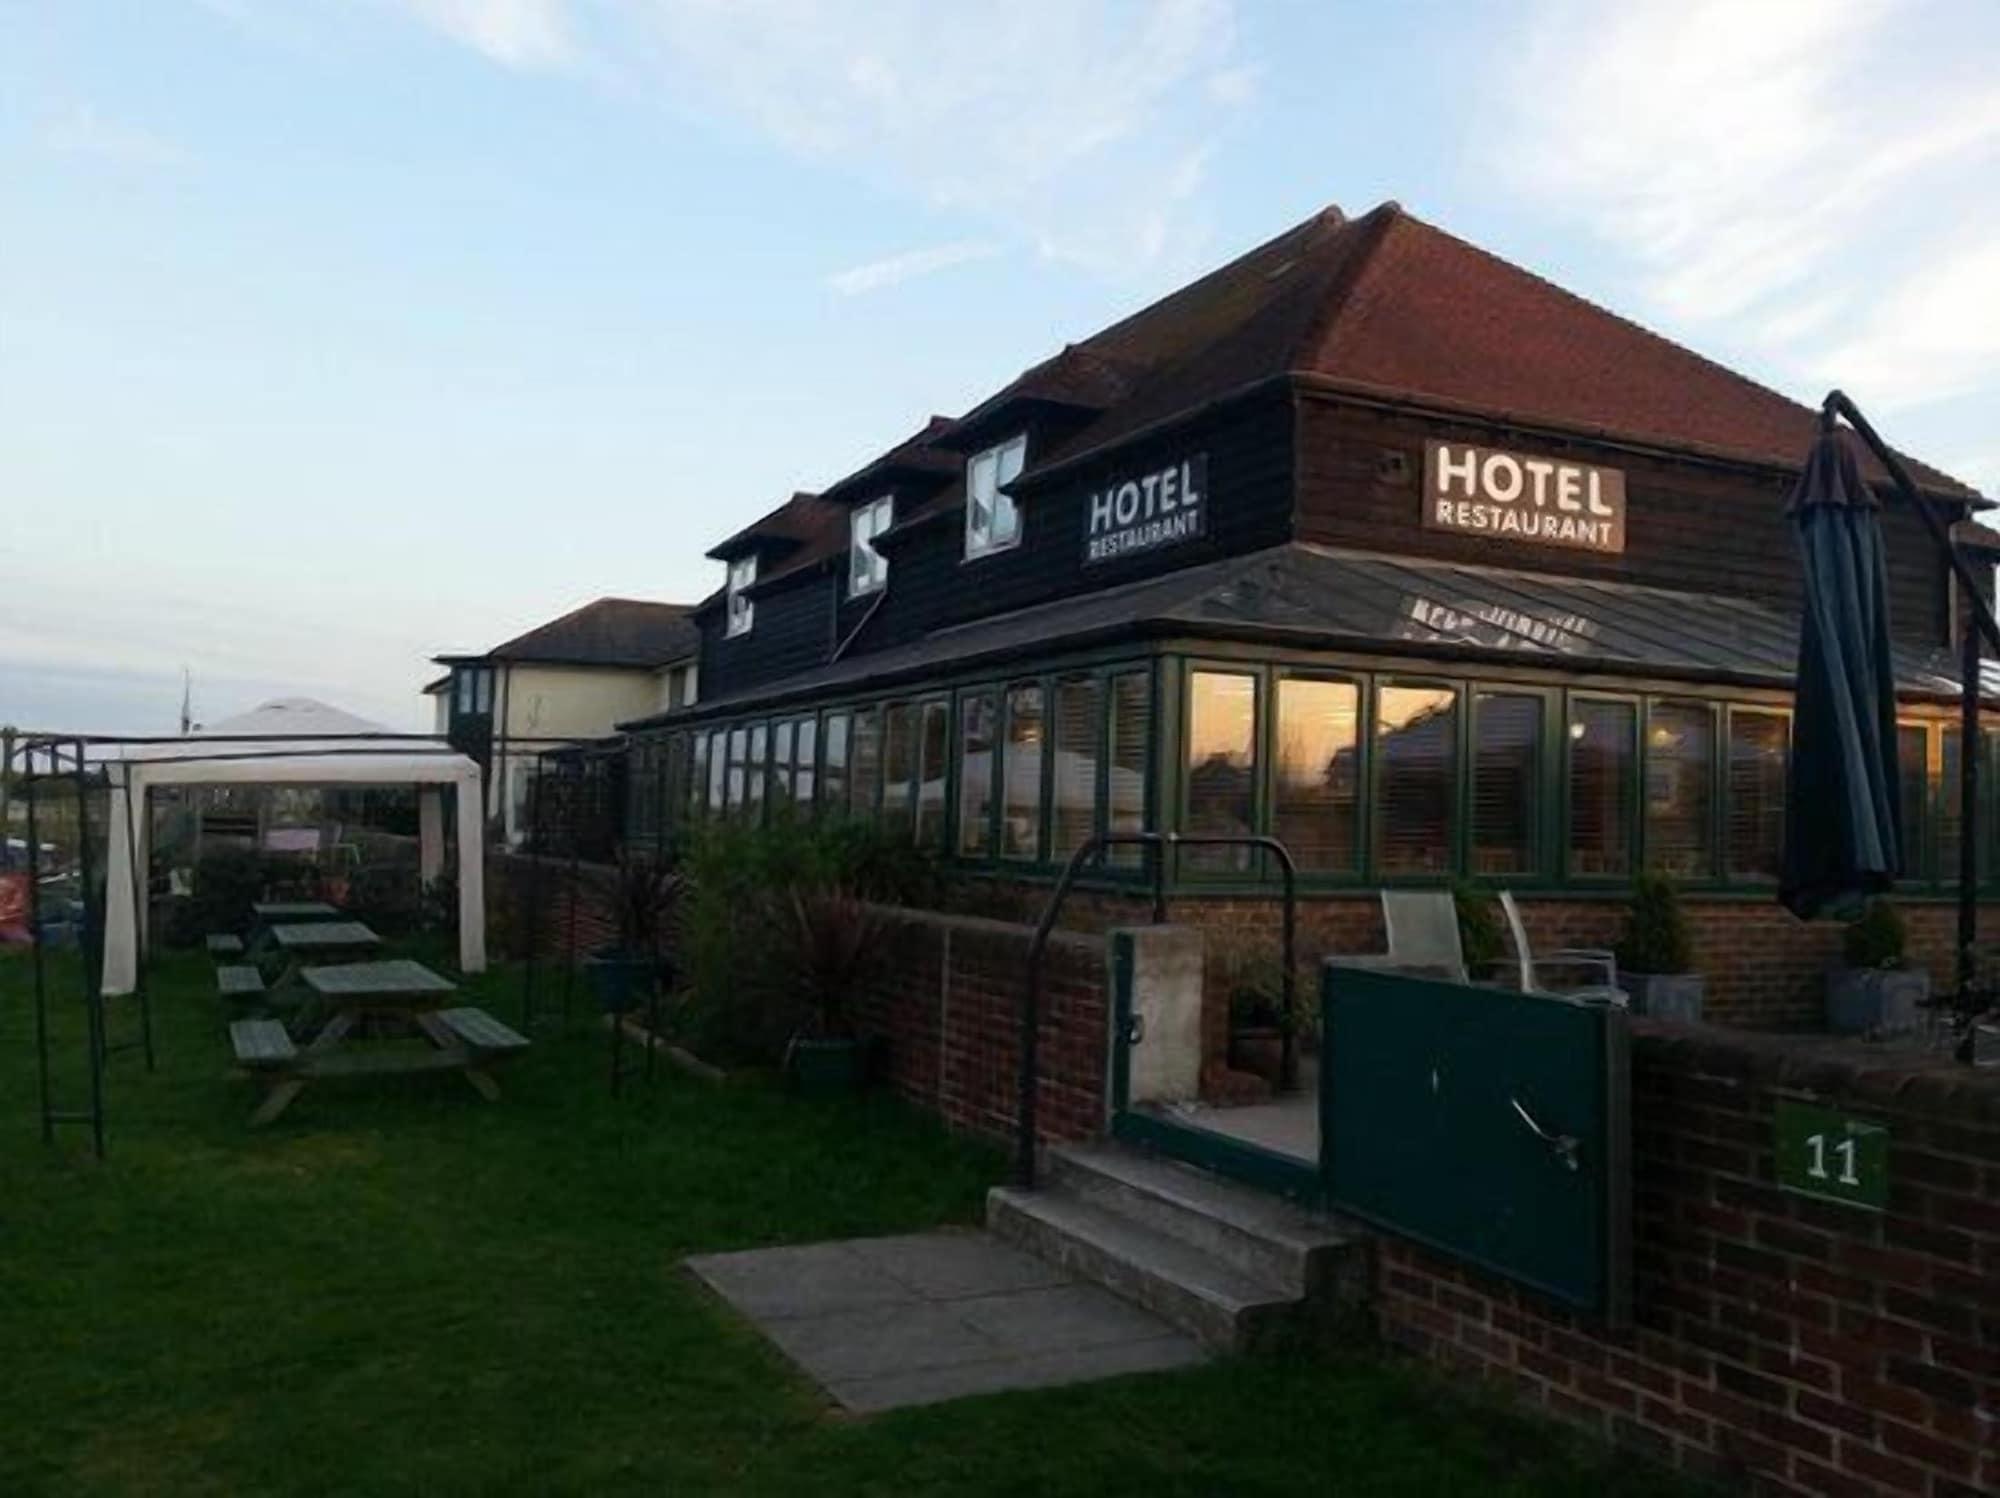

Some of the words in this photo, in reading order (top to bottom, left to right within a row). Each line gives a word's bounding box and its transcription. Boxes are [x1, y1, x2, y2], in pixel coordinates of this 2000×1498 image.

[1089, 460, 1198, 534] HOTEL
[1437, 446, 1614, 516] HOTEL
[1089, 510, 1198, 559] RESTAURANT
[1435, 498, 1613, 545] RESTAURANT
[1806, 1134, 1860, 1186] 11
